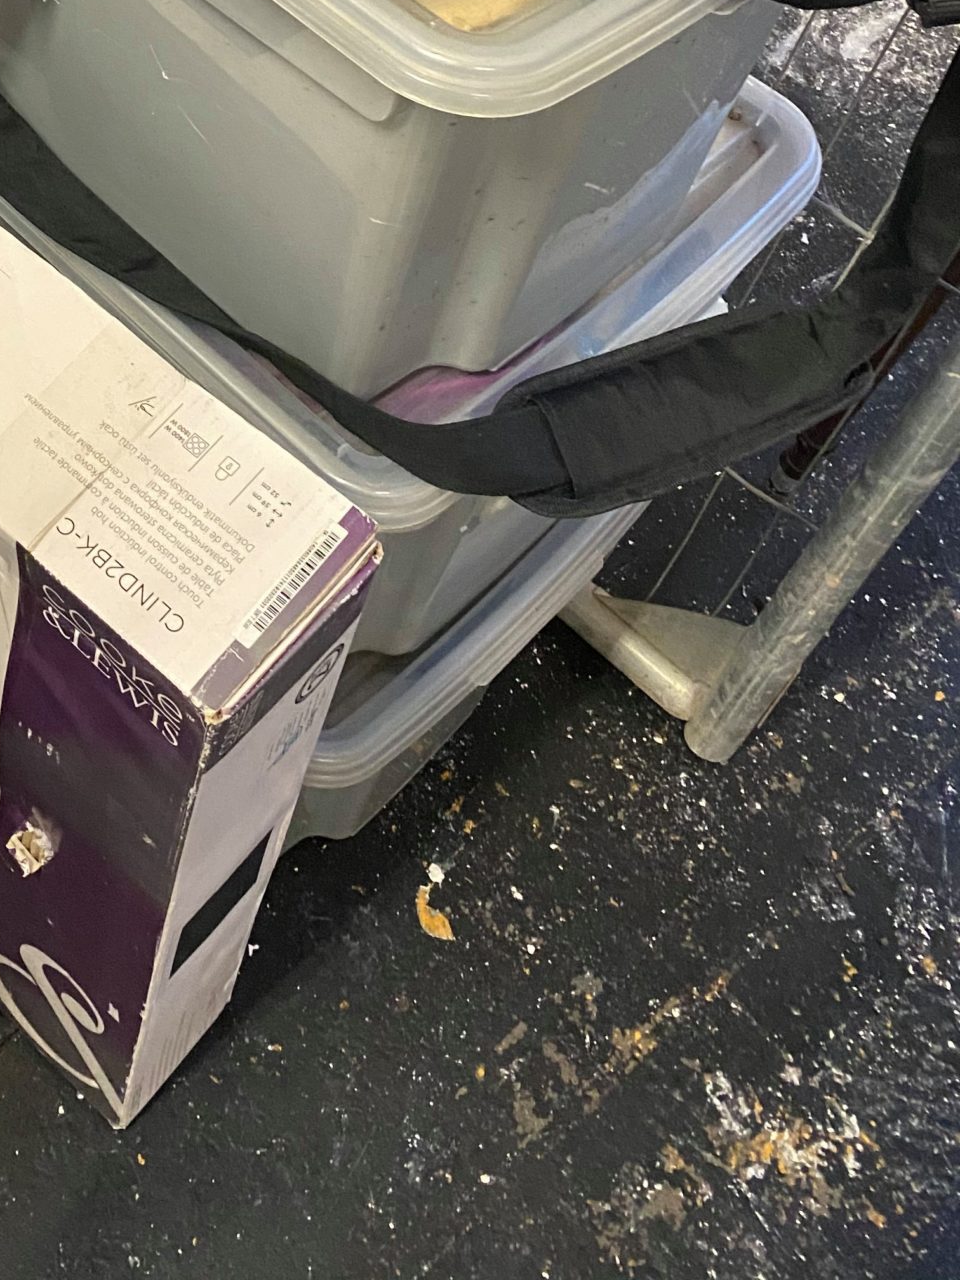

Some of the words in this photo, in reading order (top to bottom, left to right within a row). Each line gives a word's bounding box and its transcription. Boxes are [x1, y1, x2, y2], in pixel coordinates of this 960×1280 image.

[22, 390, 79, 440] управлением
[96, 419, 120, 441] ocak
[31, 435, 58, 461] tactile
[135, 451, 152, 466] set
[55, 456, 103, 499] commande
[88, 504, 109, 524] hob
[106, 501, 148, 539] induction
[112, 487, 158, 528] sterowana
[127, 480, 175, 523] конфорка
[166, 496, 210, 535] inducción
[106, 520, 148, 558] induction
[155, 523, 205, 567] ceramiczna
[171, 517, 236, 575] Керамическая
[201, 506, 255, 554] Dokunmatik
[206, 530, 222, 545] de
[144, 553, 179, 585] control
[145, 534, 180, 566] cuisson
[176, 561, 192, 577] de
[219, 540, 245, 565] Placa
[54, 514, 187, 636] CLIND2BK-C
[188, 572, 215, 597] Table
[175, 580, 206, 609] Touch
[71, 631, 180, 748] LEWIS
